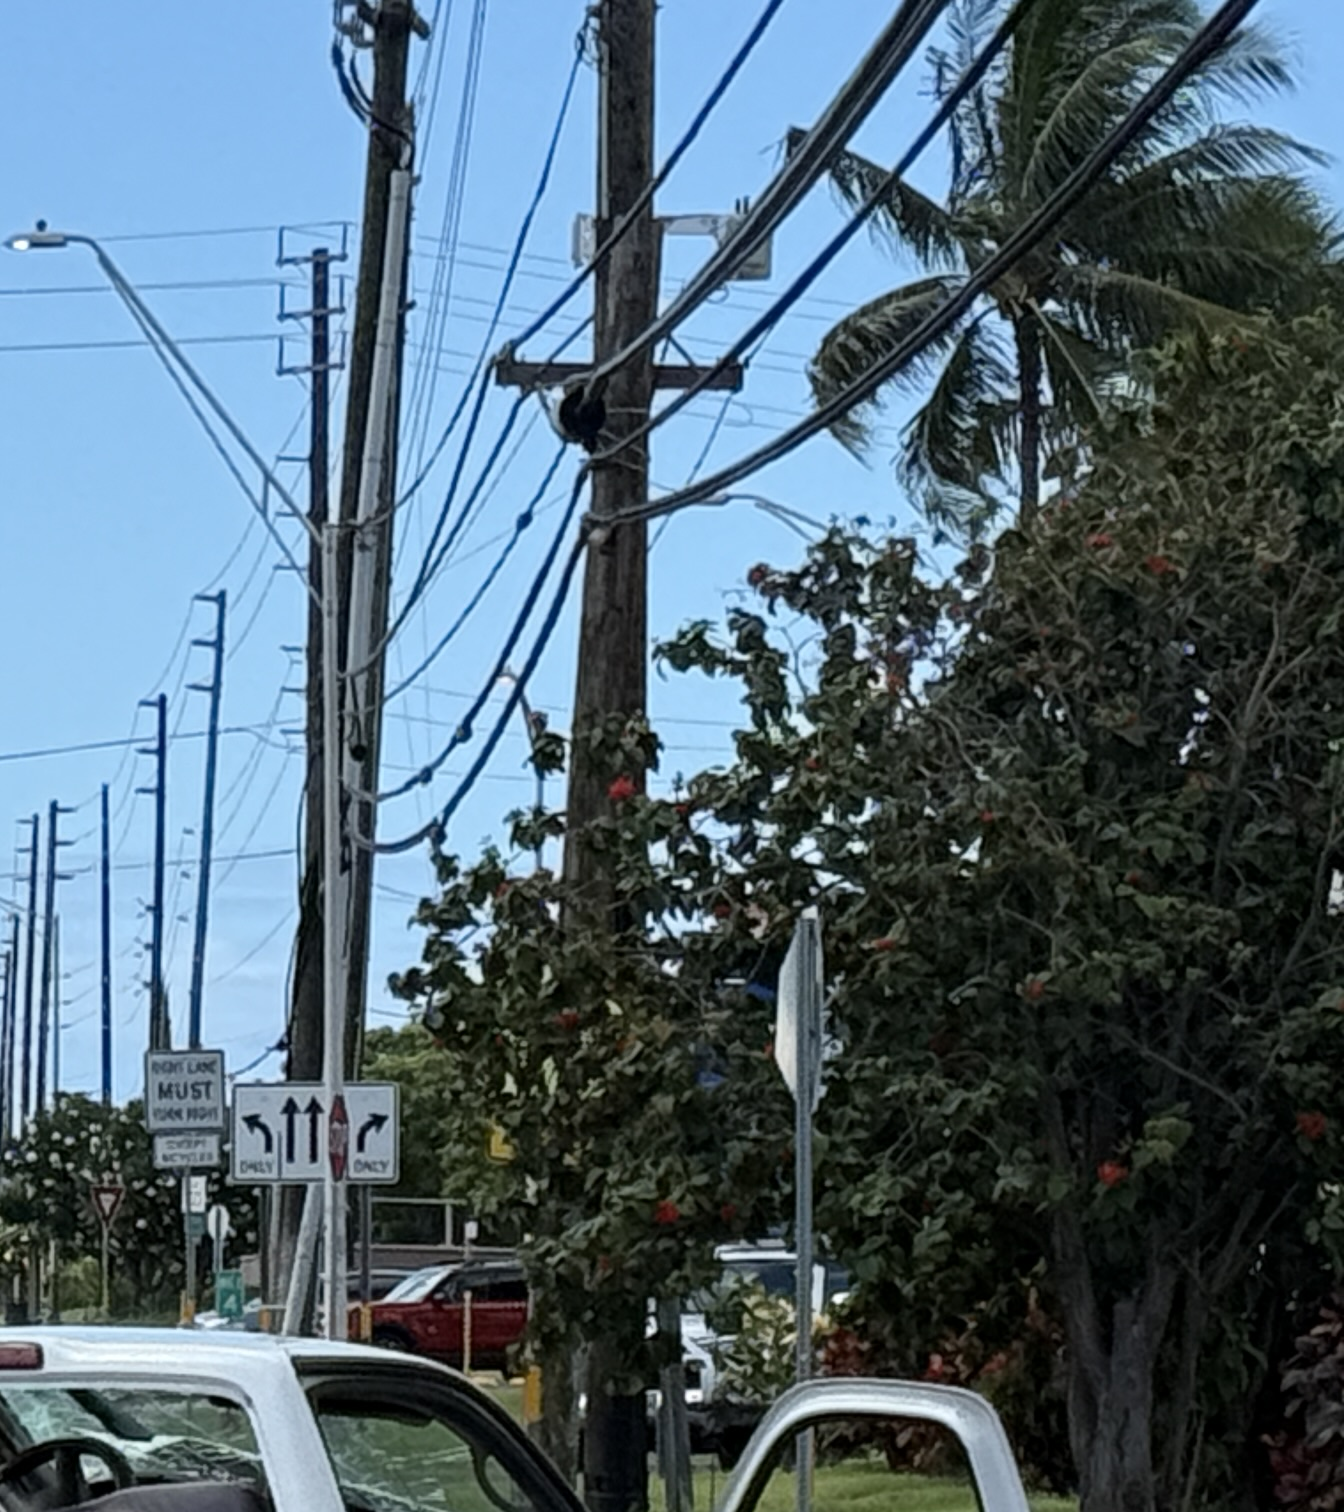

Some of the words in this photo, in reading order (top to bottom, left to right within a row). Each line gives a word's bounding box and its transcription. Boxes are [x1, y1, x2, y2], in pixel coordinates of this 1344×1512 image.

[158, 1081, 213, 1101] MUST
[240, 1160, 274, 1174] ONLY
[354, 1160, 389, 1174] ONLY
